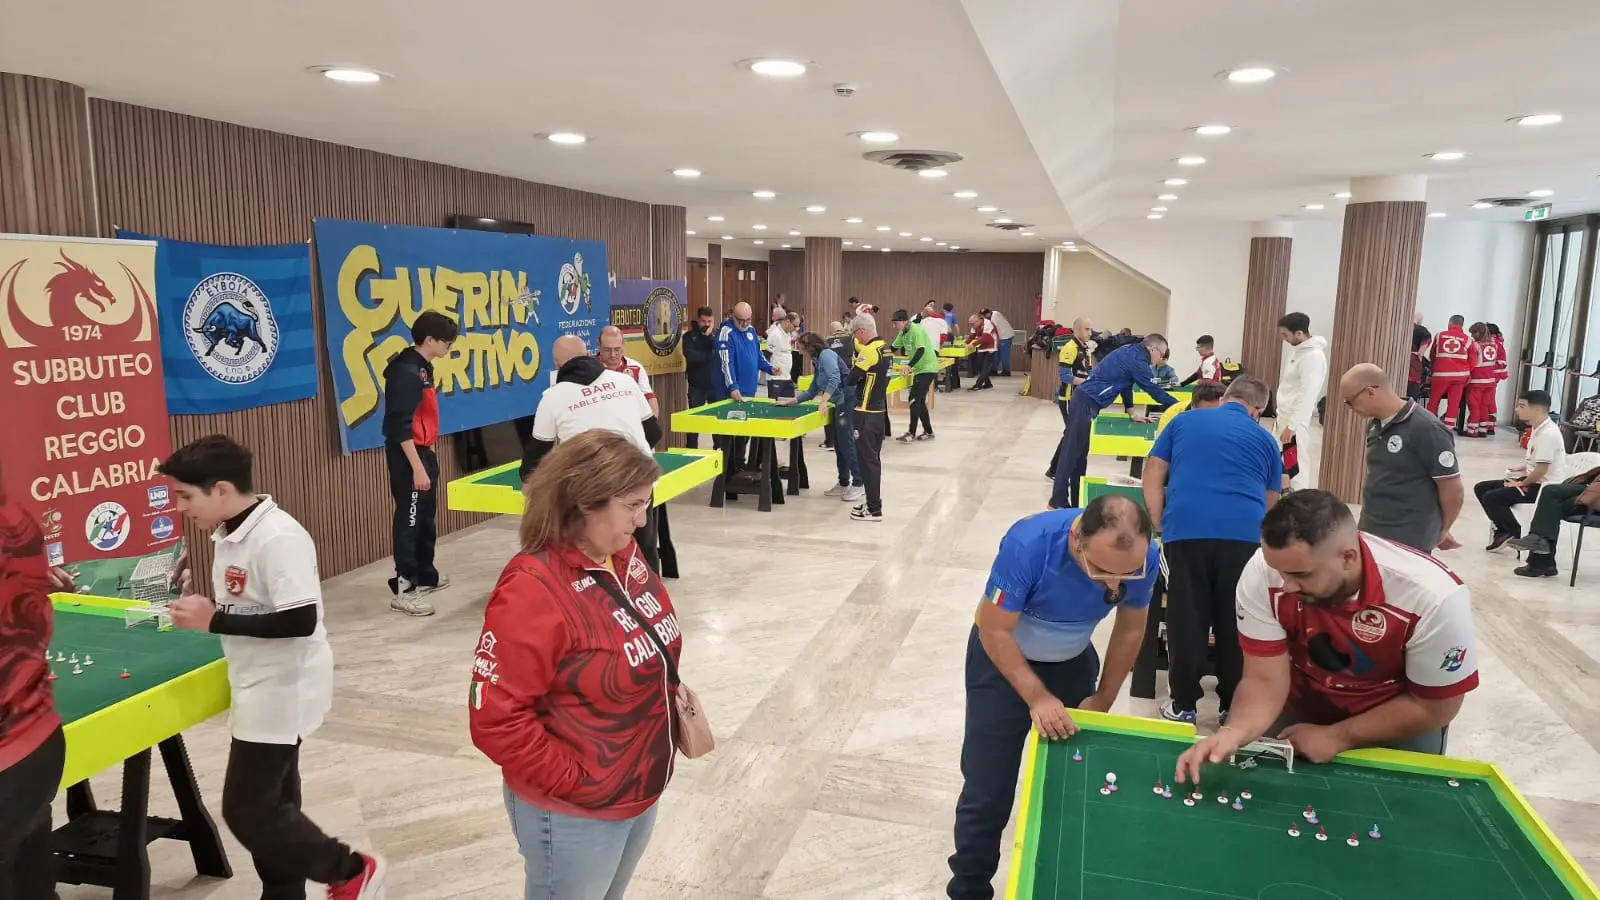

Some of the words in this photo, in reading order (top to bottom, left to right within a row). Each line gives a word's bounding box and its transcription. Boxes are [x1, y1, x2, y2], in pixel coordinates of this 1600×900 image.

[338, 244, 530, 332] GUERIN
[558, 318, 597, 329] FEDERAZIONE
[610, 308, 641, 326] UBBUTEO
[62, 324, 102, 341] 1974
[12, 352, 153, 386] SUBBUTEO
[340, 329, 540, 426] SPRTIVO
[581, 381, 616, 397] BARI
[56, 391, 126, 420] CLUB
[568, 397, 599, 412] TABLE
[44, 424, 146, 461] REGGIO
[30, 456, 167, 502] CALABRIA
[150, 490, 167, 500] LND
[612, 591, 662, 633] REGIO
